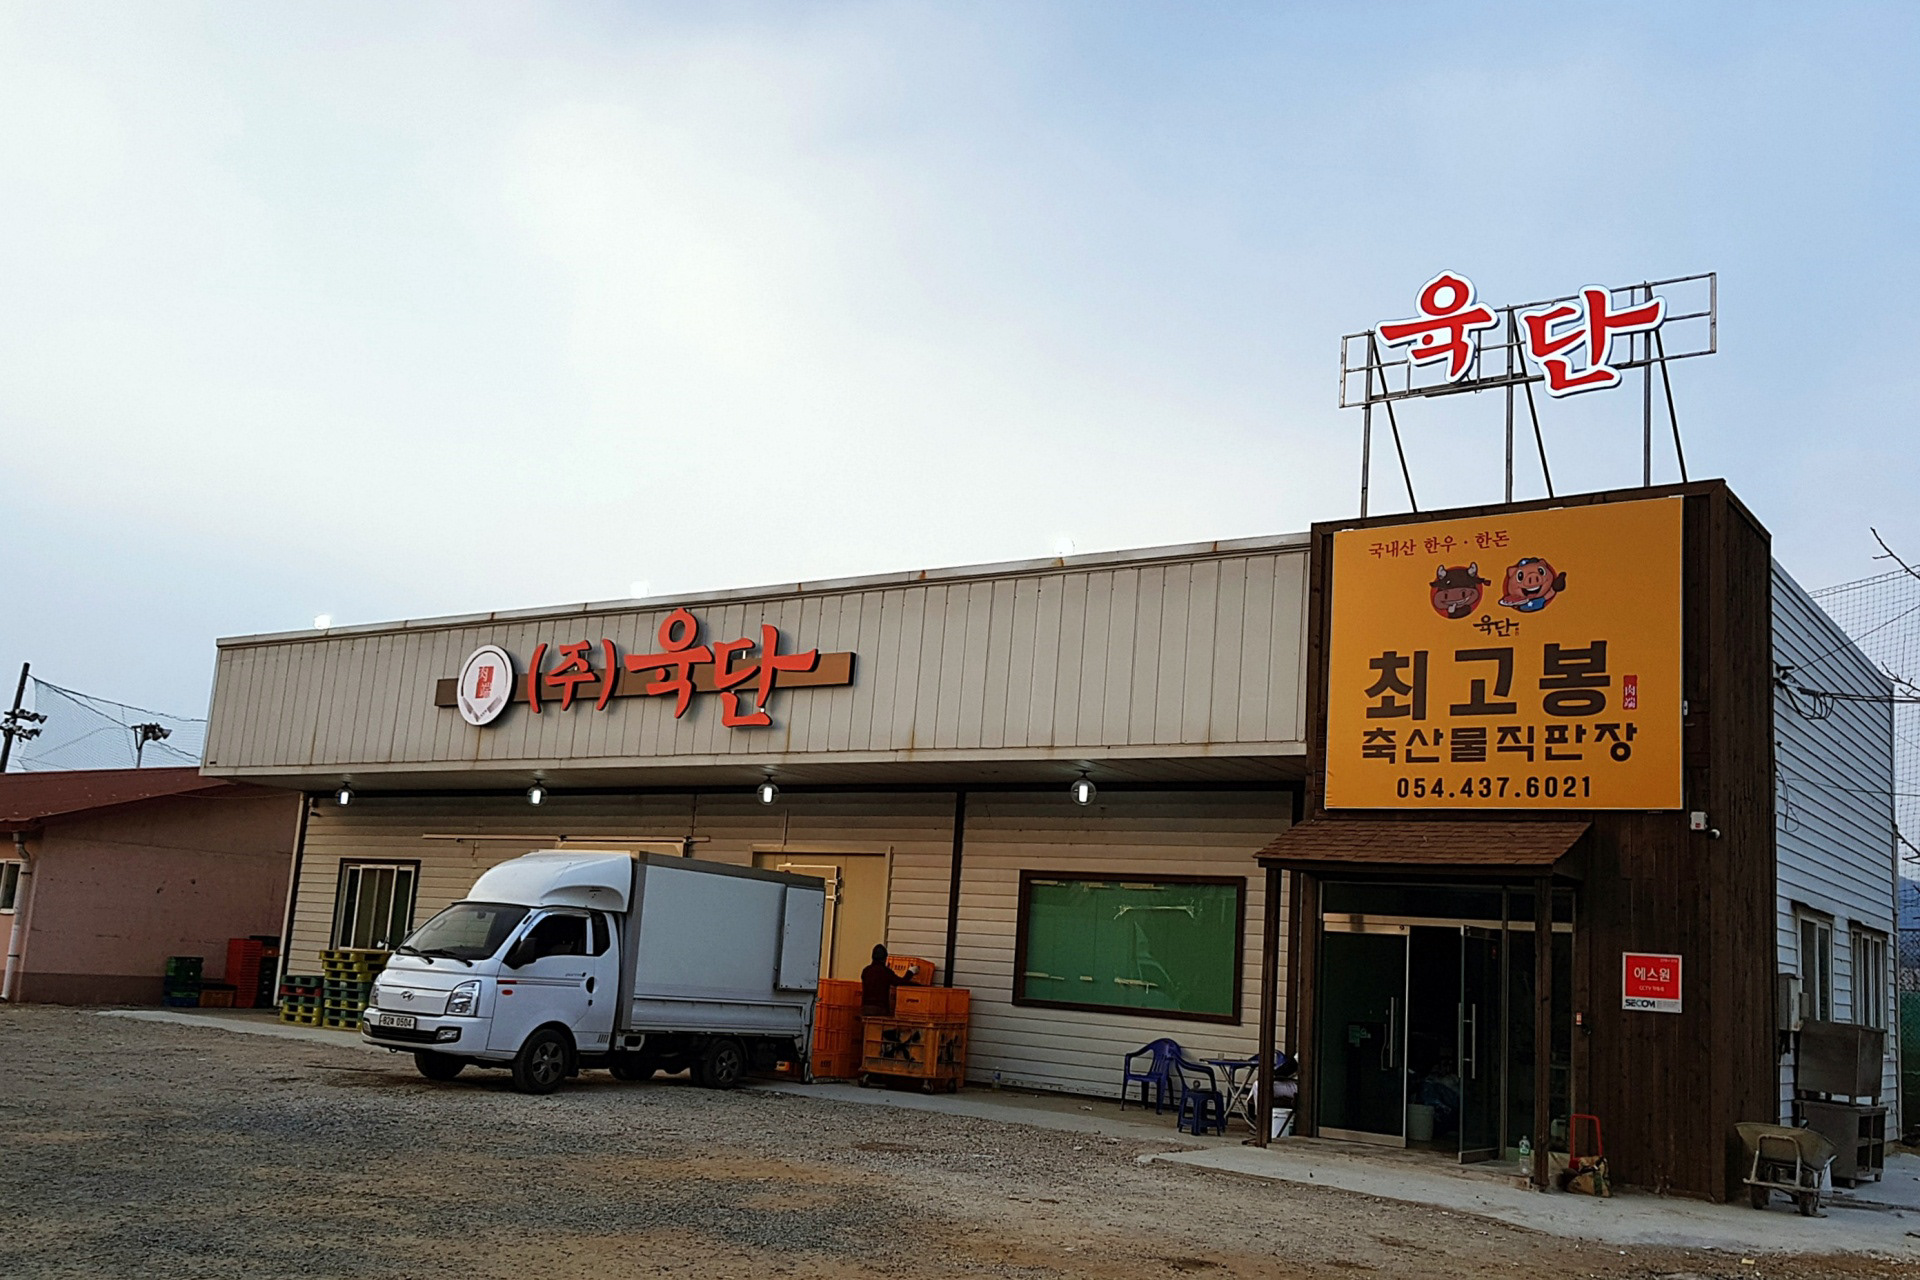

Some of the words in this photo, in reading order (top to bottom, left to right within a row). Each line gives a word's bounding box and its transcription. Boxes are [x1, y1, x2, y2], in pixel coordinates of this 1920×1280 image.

[1376, 270, 1665, 397] 육단
[1368, 539, 1416, 559] 국내산
[1424, 535, 1457, 554] 한우
[1475, 530, 1510, 549] 한돈
[1472, 615, 1520, 637] 육단
[527, 637, 616, 713] (주)
[624, 607, 817, 728] 육단
[1364, 640, 1611, 721] 최고봉
[1362, 722, 1638, 764] 축산물직판장
[1396, 776, 1592, 799] 054.437.6021
[1634, 967, 1670, 982] 에스원
[1625, 999, 1656, 1008] SECOM
